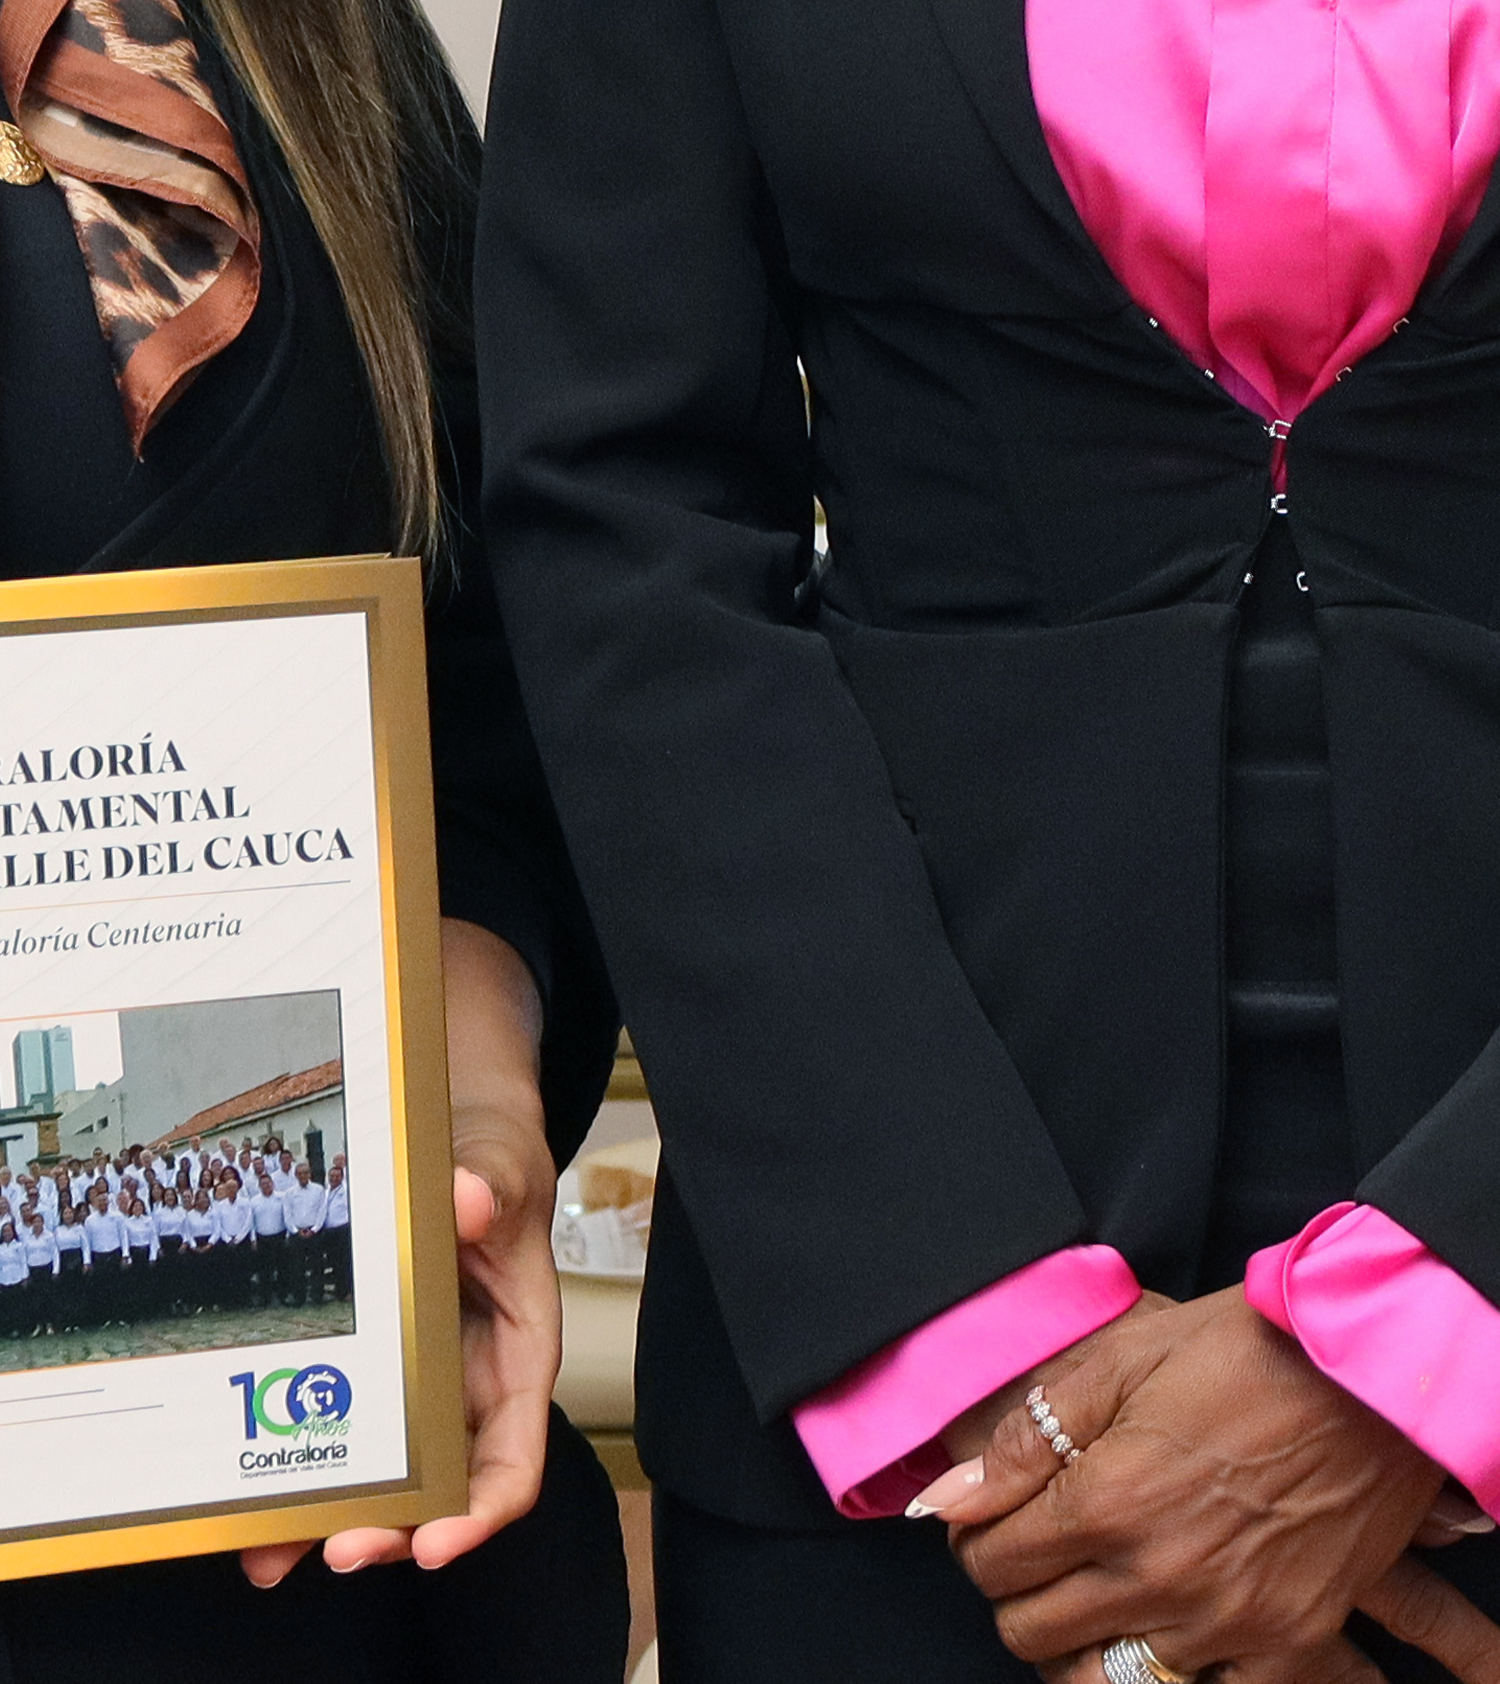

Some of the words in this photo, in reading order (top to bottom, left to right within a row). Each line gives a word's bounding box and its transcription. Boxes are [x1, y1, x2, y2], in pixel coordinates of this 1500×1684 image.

[101, 840, 195, 881] DEL
[203, 827, 355, 871] CAUCA
[87, 912, 243, 949] Centenaria
[239, 1440, 348, 1471] Contraloría
